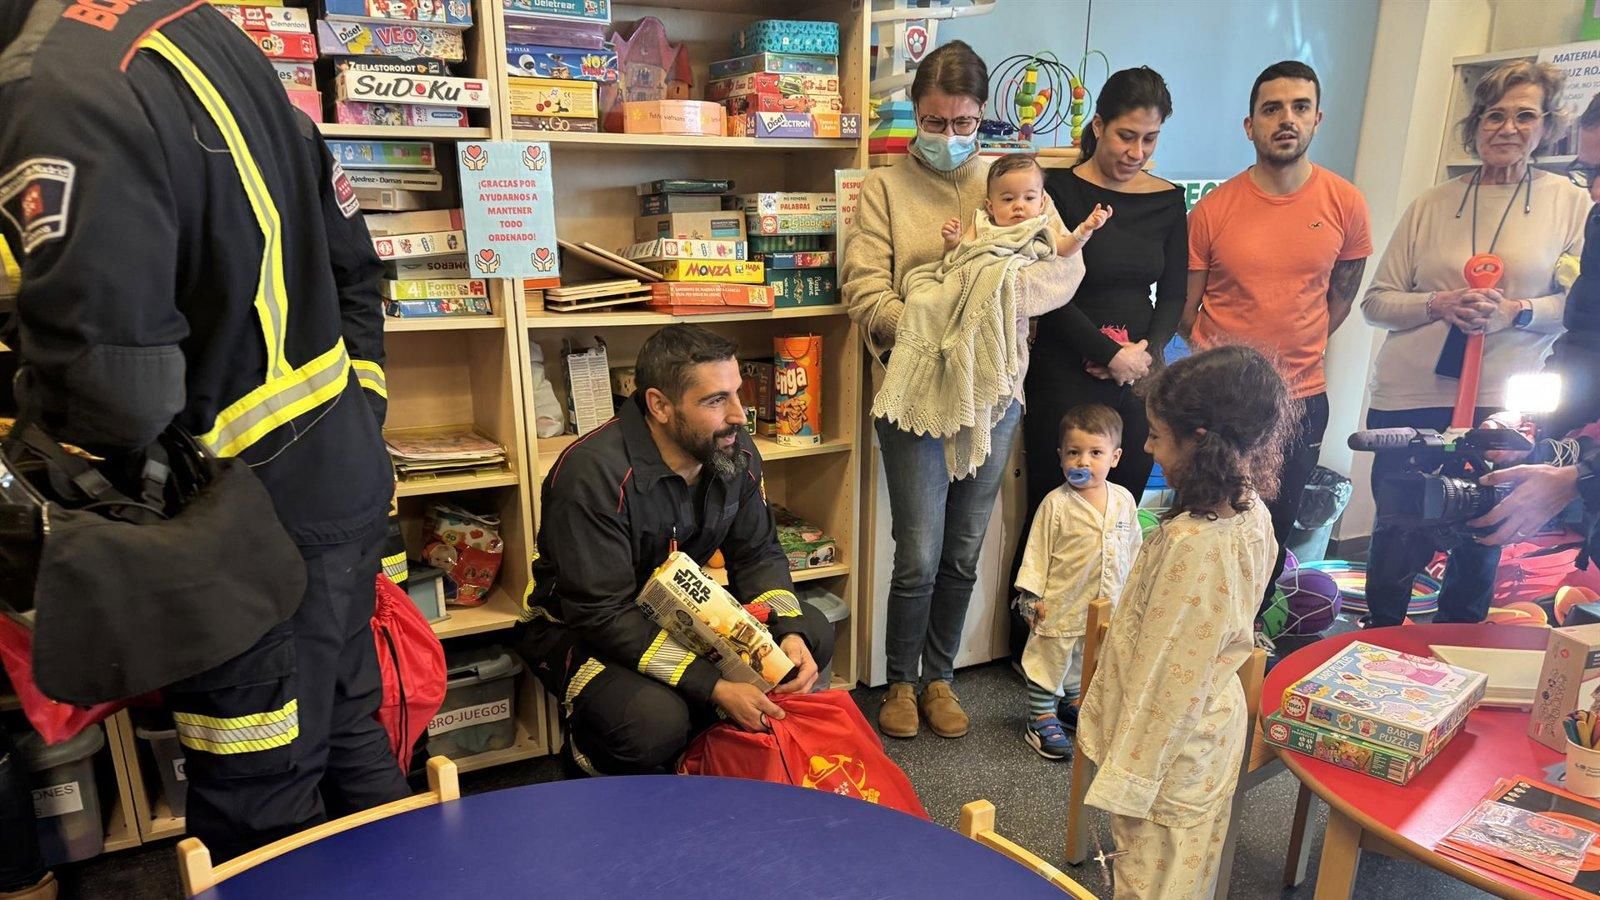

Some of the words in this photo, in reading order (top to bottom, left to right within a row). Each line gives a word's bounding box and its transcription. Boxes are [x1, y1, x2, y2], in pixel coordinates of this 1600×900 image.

[534, 0, 576, 10] Deletrear
[339, 25, 362, 41] Diset
[375, 27, 418, 45] VEO
[348, 61, 416, 73] ZEELASTOROBOT
[767, 115, 785, 129] Diset
[479, 180, 518, 190] ¡GRACIAS
[520, 180, 537, 188] POR
[480, 193, 530, 201] AYUDARNOS
[487, 207, 533, 215] MANTENER
[500, 220, 523, 228] TODO
[488, 233, 537, 242] ORDENADO!
[685, 263, 731, 276] MONZA
[672, 571, 709, 604] WARS
[678, 568, 711, 600] STAR
[683, 598, 701, 614] FETT
[1387, 726, 1413, 739] BABY
[1379, 732, 1420, 751] PUZZLES
